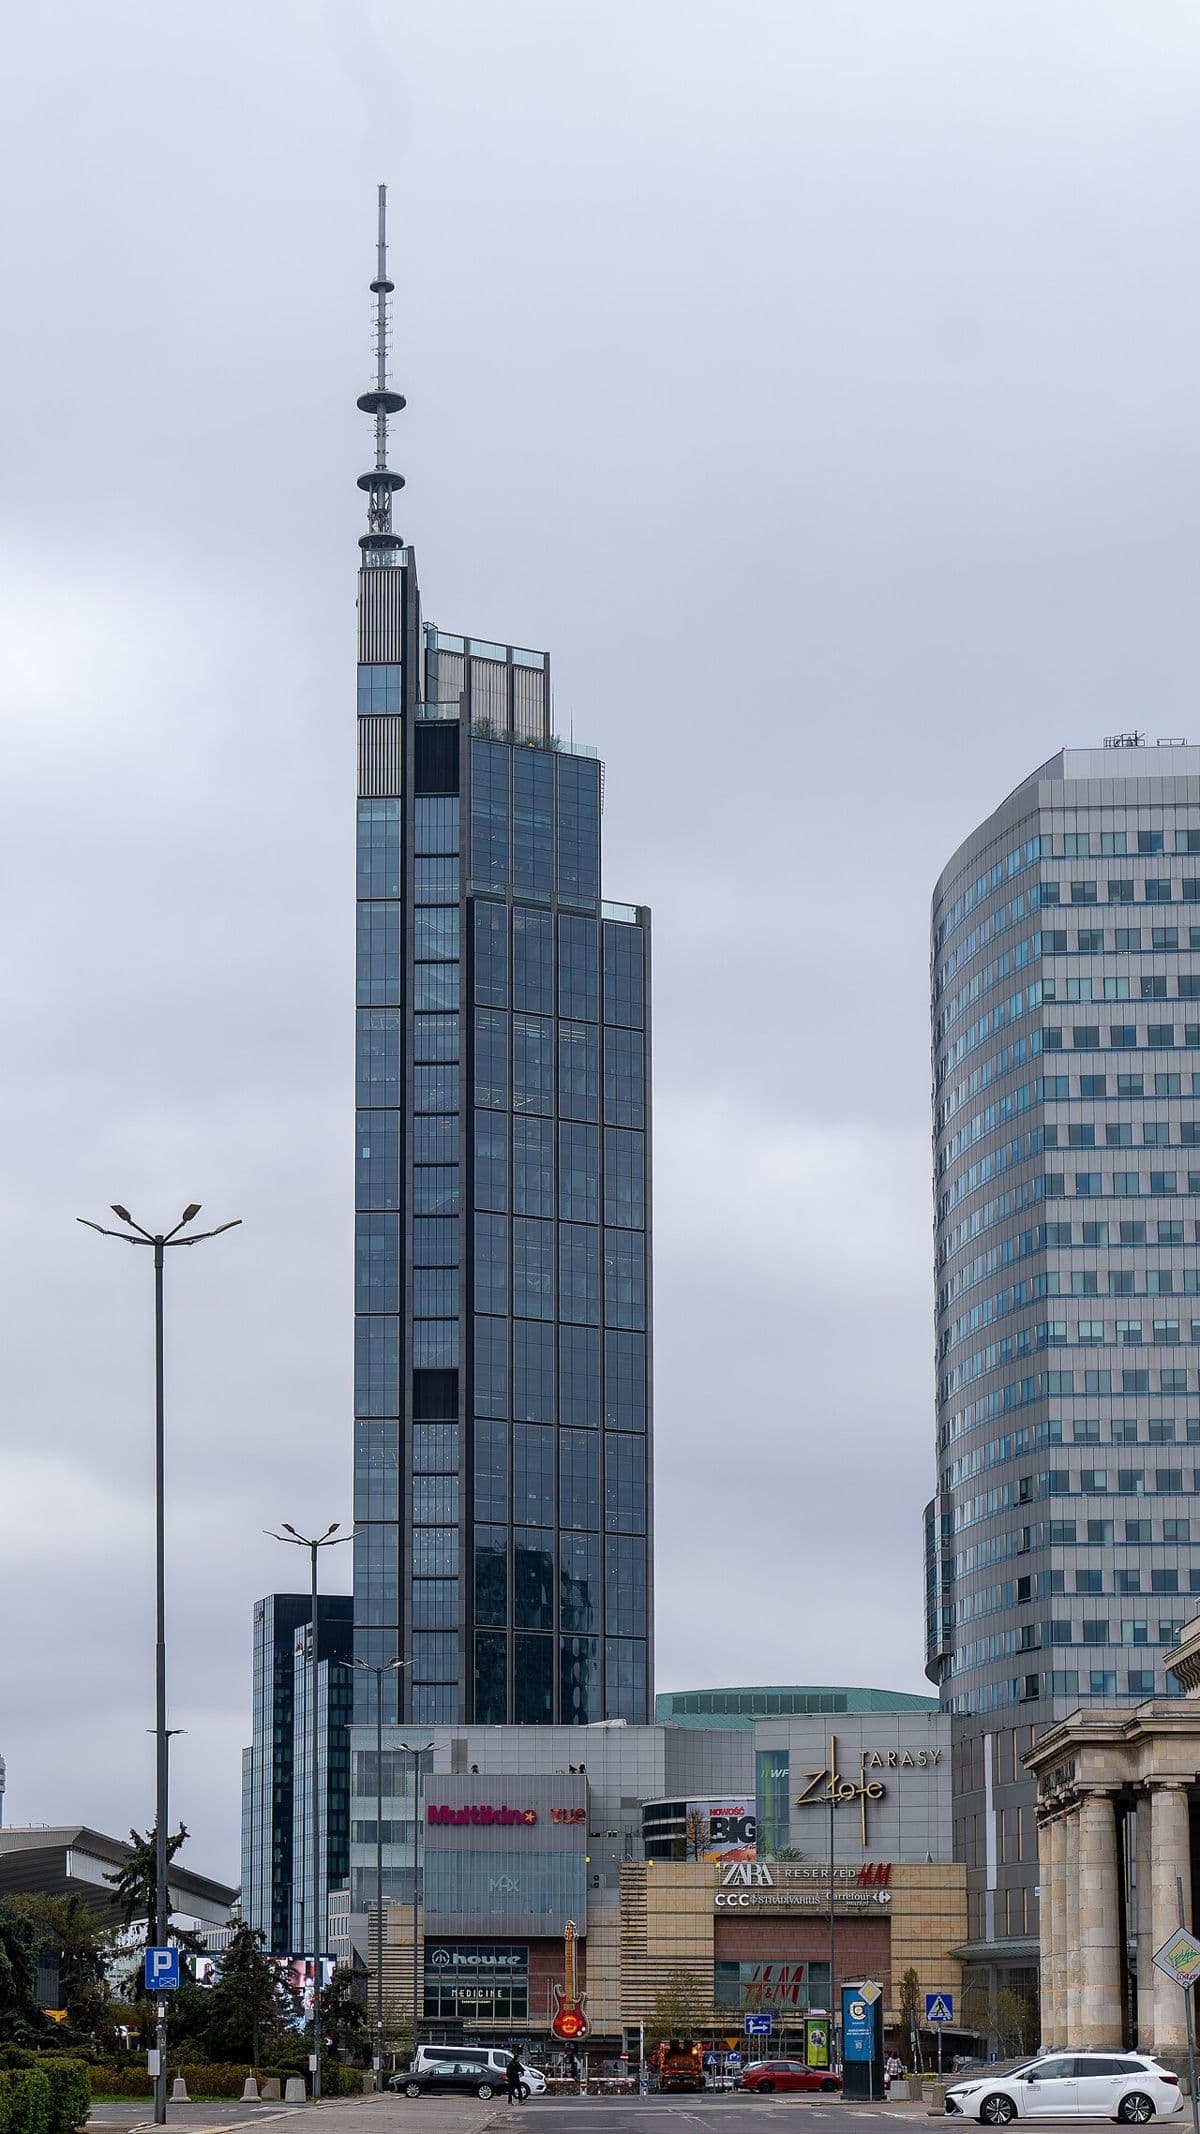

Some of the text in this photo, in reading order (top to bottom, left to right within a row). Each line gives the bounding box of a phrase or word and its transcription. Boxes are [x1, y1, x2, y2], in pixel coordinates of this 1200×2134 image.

[860, 1750, 942, 1767] TARASY
[793, 1735, 886, 1846] Złote
[428, 1804, 538, 1825] Multikino
[709, 1806, 745, 1816] NOWOŚĆ
[710, 1816, 756, 1844] BIG
[721, 1862, 777, 1886] ZARA
[715, 1893, 750, 1906] CCC
[758, 1895, 821, 1905] STRADIVARIUS
[826, 1891, 871, 1901] Carrefour
[153, 1951, 172, 1977] P
[452, 1953, 521, 1965] house
[744, 1964, 805, 2005] H&M
[451, 1989, 503, 1998] MEDICINE
